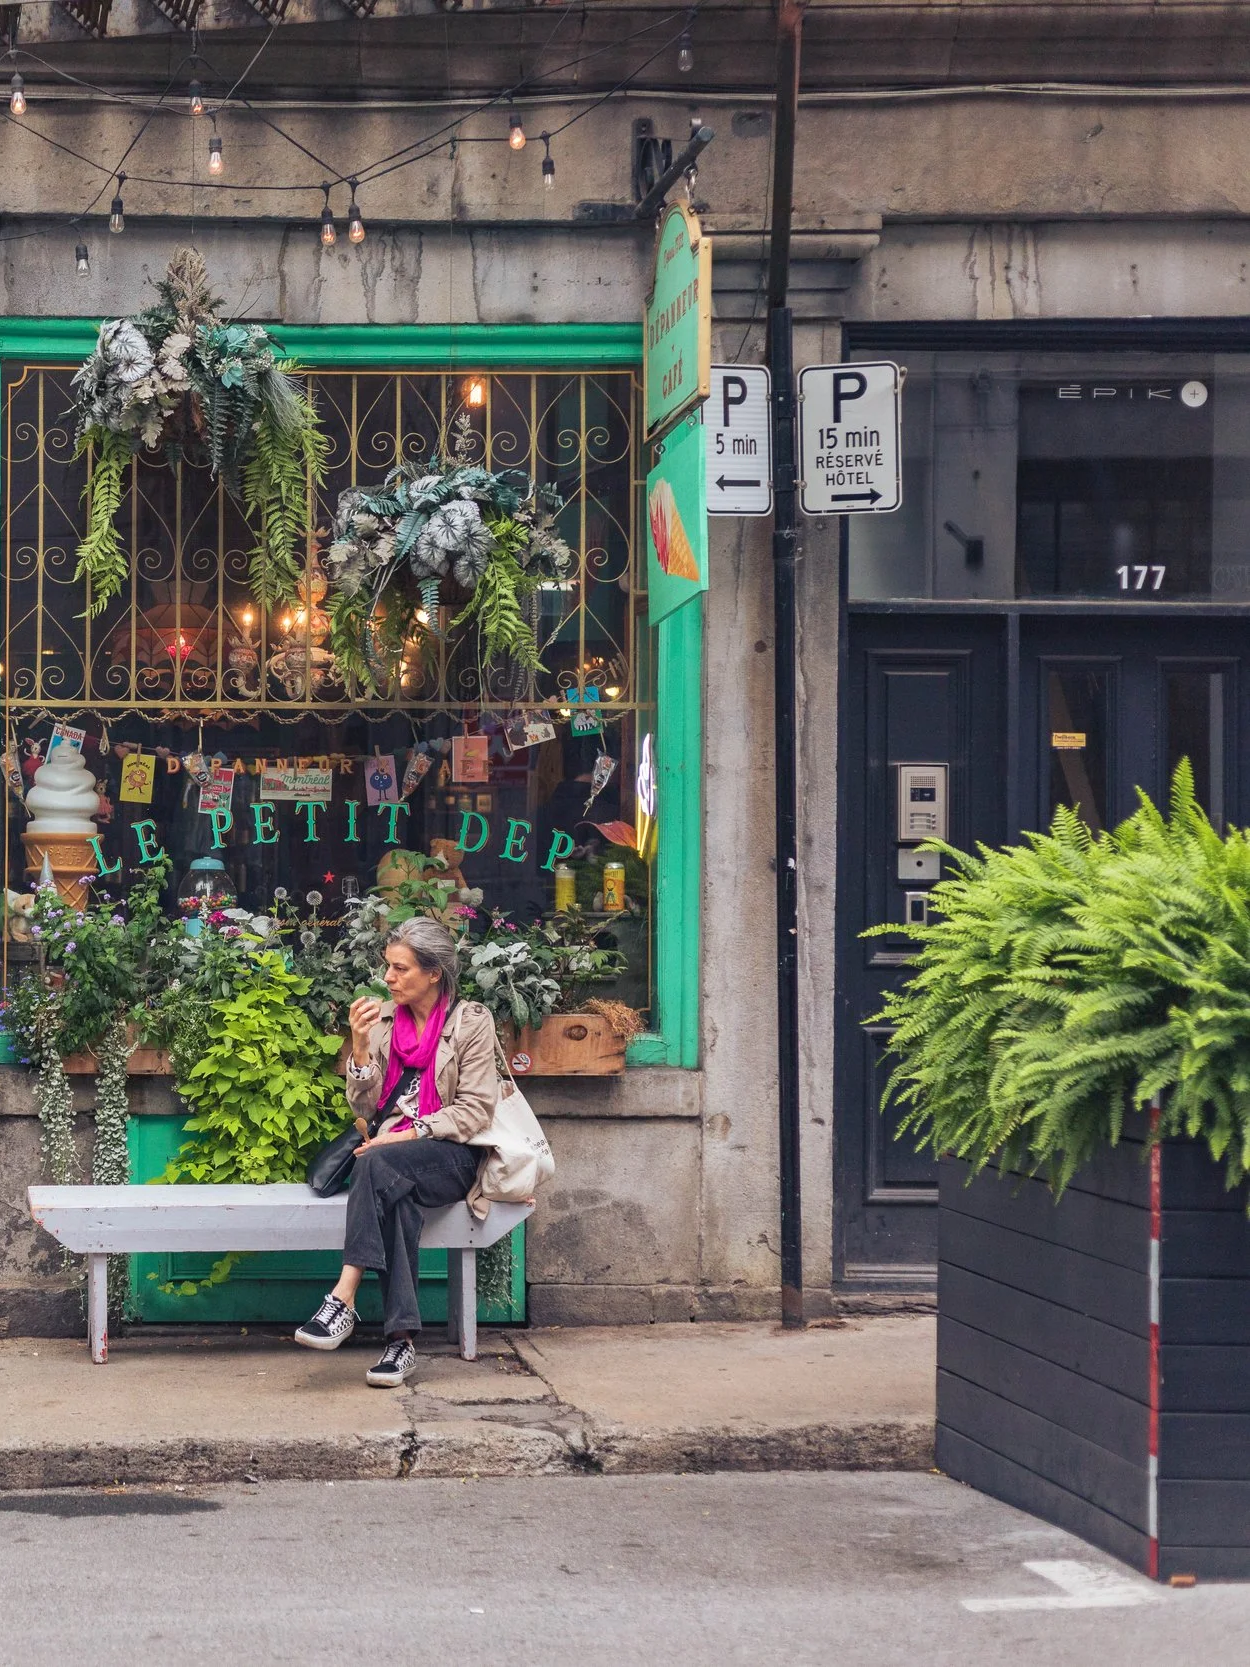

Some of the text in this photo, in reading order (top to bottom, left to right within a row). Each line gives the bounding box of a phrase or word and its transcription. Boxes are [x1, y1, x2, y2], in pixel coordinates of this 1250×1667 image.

[650, 278, 699, 350] DÉPANNEUR
[662, 350, 683, 400] CAFÉ
[723, 375, 748, 427] P
[833, 371, 868, 423] P
[716, 433, 757, 455] 5 min
[818, 426, 880, 449] 15 min
[816, 449, 884, 469] RÉSERVÉ
[826, 470, 874, 486] HÔTEL
[1116, 565, 1166, 590] 177
[86, 800, 575, 877] LE PETIT DEP
